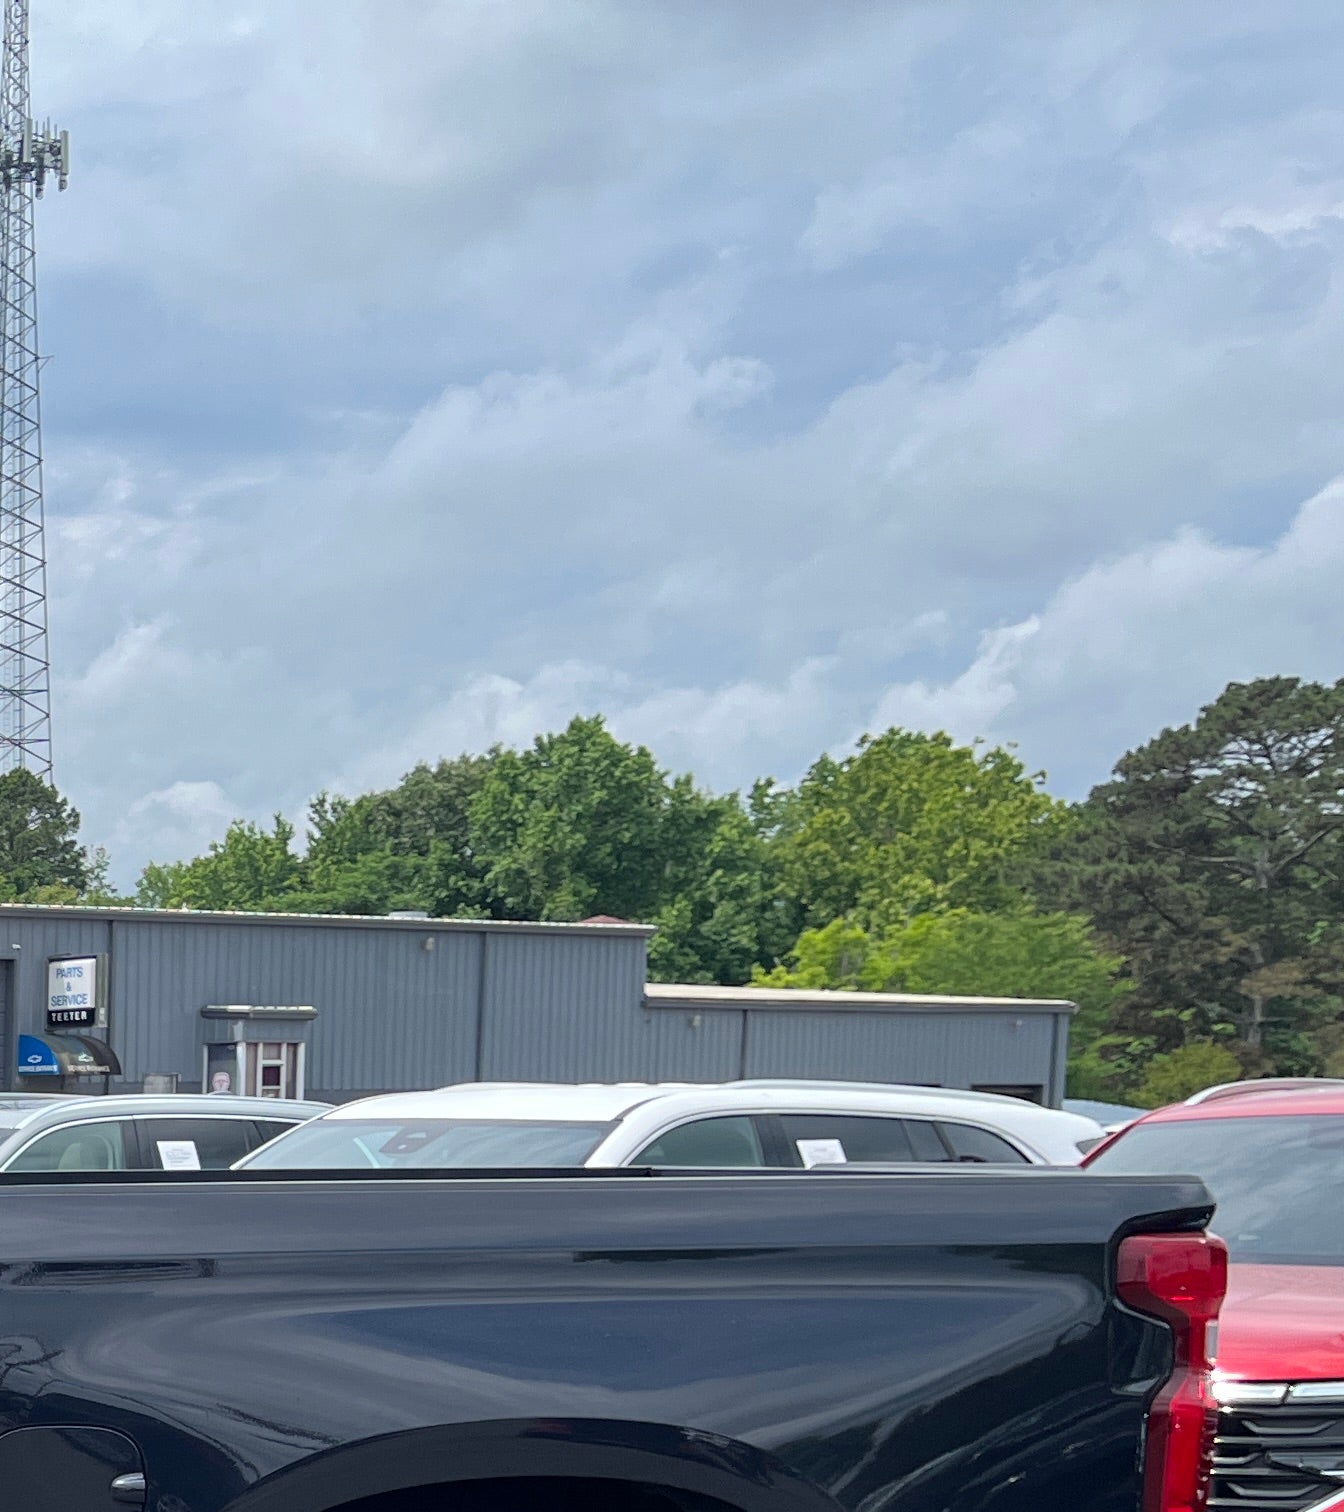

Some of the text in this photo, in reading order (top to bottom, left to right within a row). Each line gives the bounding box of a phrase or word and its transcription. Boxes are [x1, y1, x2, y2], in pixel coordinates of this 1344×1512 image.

[56, 966, 83, 978] PARTS
[65, 981, 72, 992] &
[51, 994, 87, 1006] SERVICE
[52, 1011, 87, 1021] TEETER
